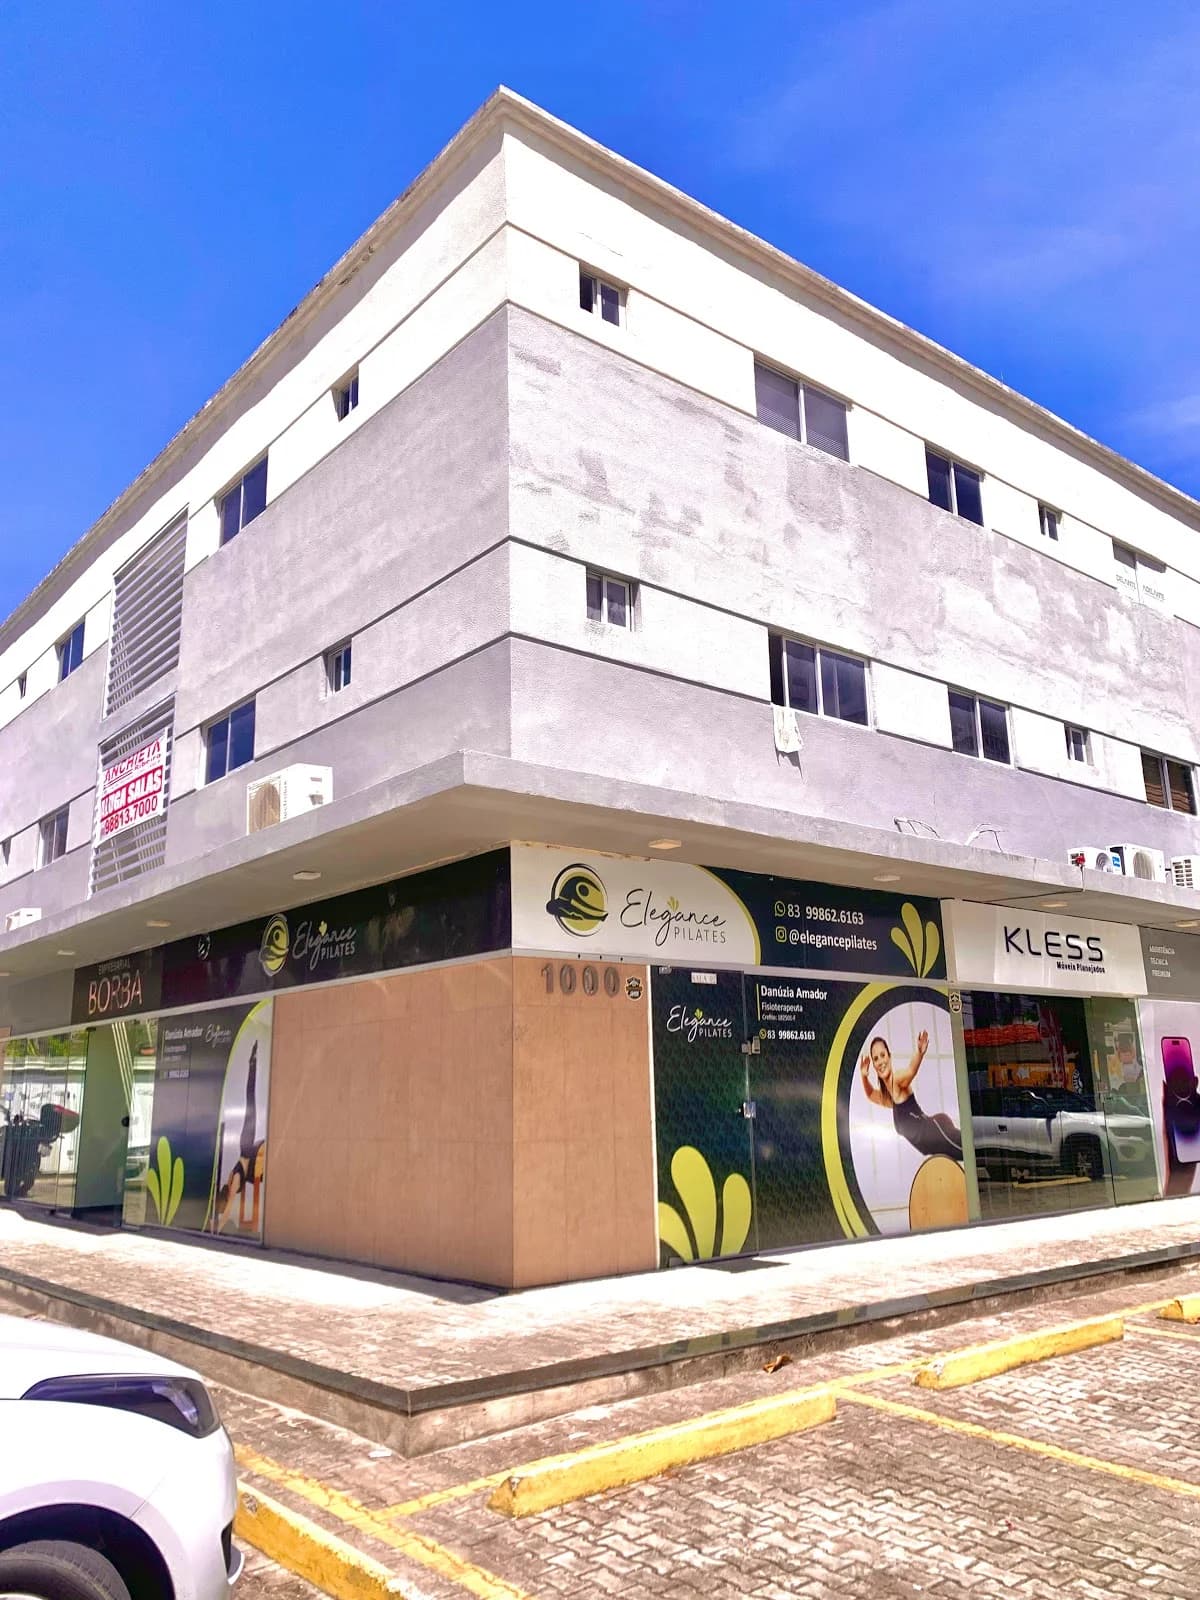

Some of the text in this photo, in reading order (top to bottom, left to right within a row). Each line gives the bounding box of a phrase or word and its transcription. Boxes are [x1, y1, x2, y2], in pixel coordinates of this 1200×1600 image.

[127, 767, 162, 806] SALAS
[104, 796, 159, 834] 98813.7000
[619, 888, 728, 947] Elegance
[787, 903, 865, 926] 83 99862.6163
[292, 920, 357, 971] Elegance
[673, 926, 727, 944] PILATES
[788, 929, 878, 951] @elegancepilates
[1003, 925, 1104, 963] KLESS
[320, 940, 356, 961] PILATES
[88, 968, 143, 1015] BORBA
[541, 963, 621, 998] 1000
[760, 985, 829, 1001] Danúzia Amador
[761, 1001, 804, 1014] Fisioterapeuta
[666, 1004, 732, 1042] Elegance
[699, 1028, 733, 1039] PILATES
[767, 1029, 816, 1041] 83 99862.6163
